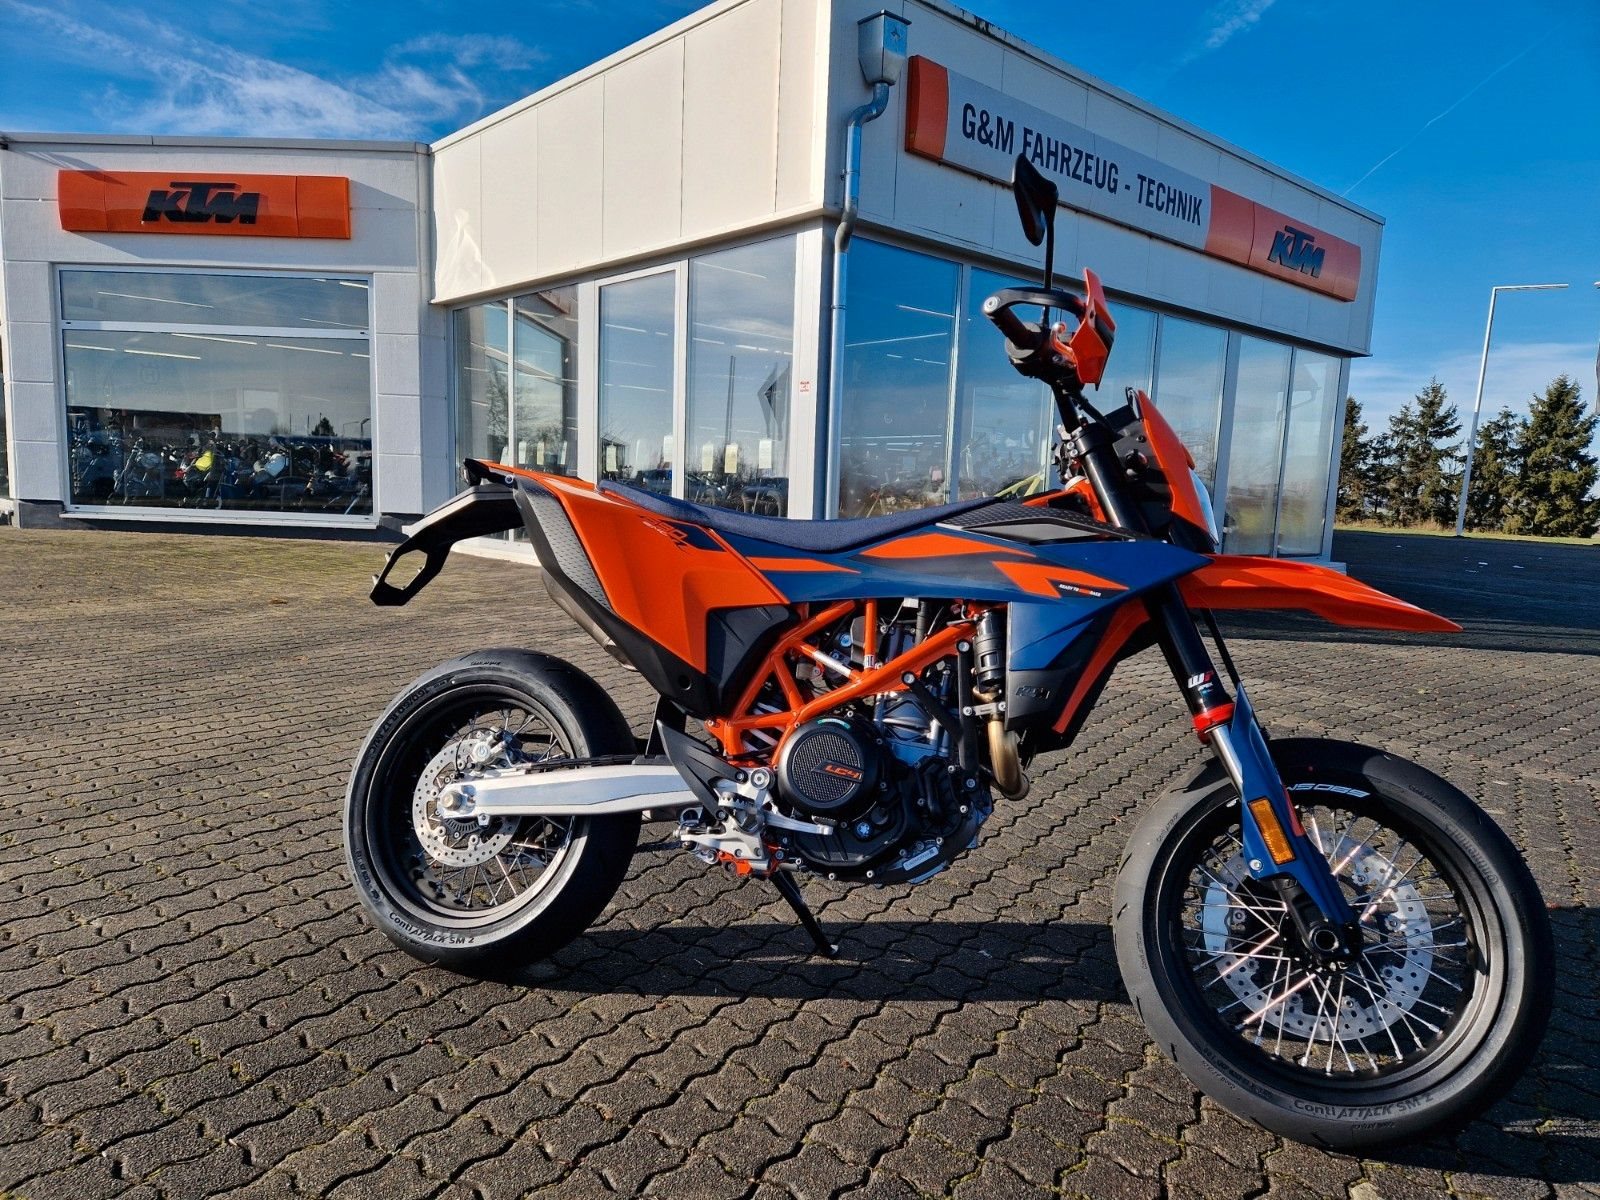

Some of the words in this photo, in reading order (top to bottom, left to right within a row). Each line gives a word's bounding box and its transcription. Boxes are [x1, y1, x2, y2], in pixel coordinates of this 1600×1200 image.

[962, 102, 1015, 155] G&M
[1022, 126, 1119, 195] FAHRZEUG
[1137, 173, 1203, 226] TECHNIK
[141, 181, 261, 225] KTM
[1267, 225, 1326, 278] KTM
[1398, 1096, 1421, 1112] SM
